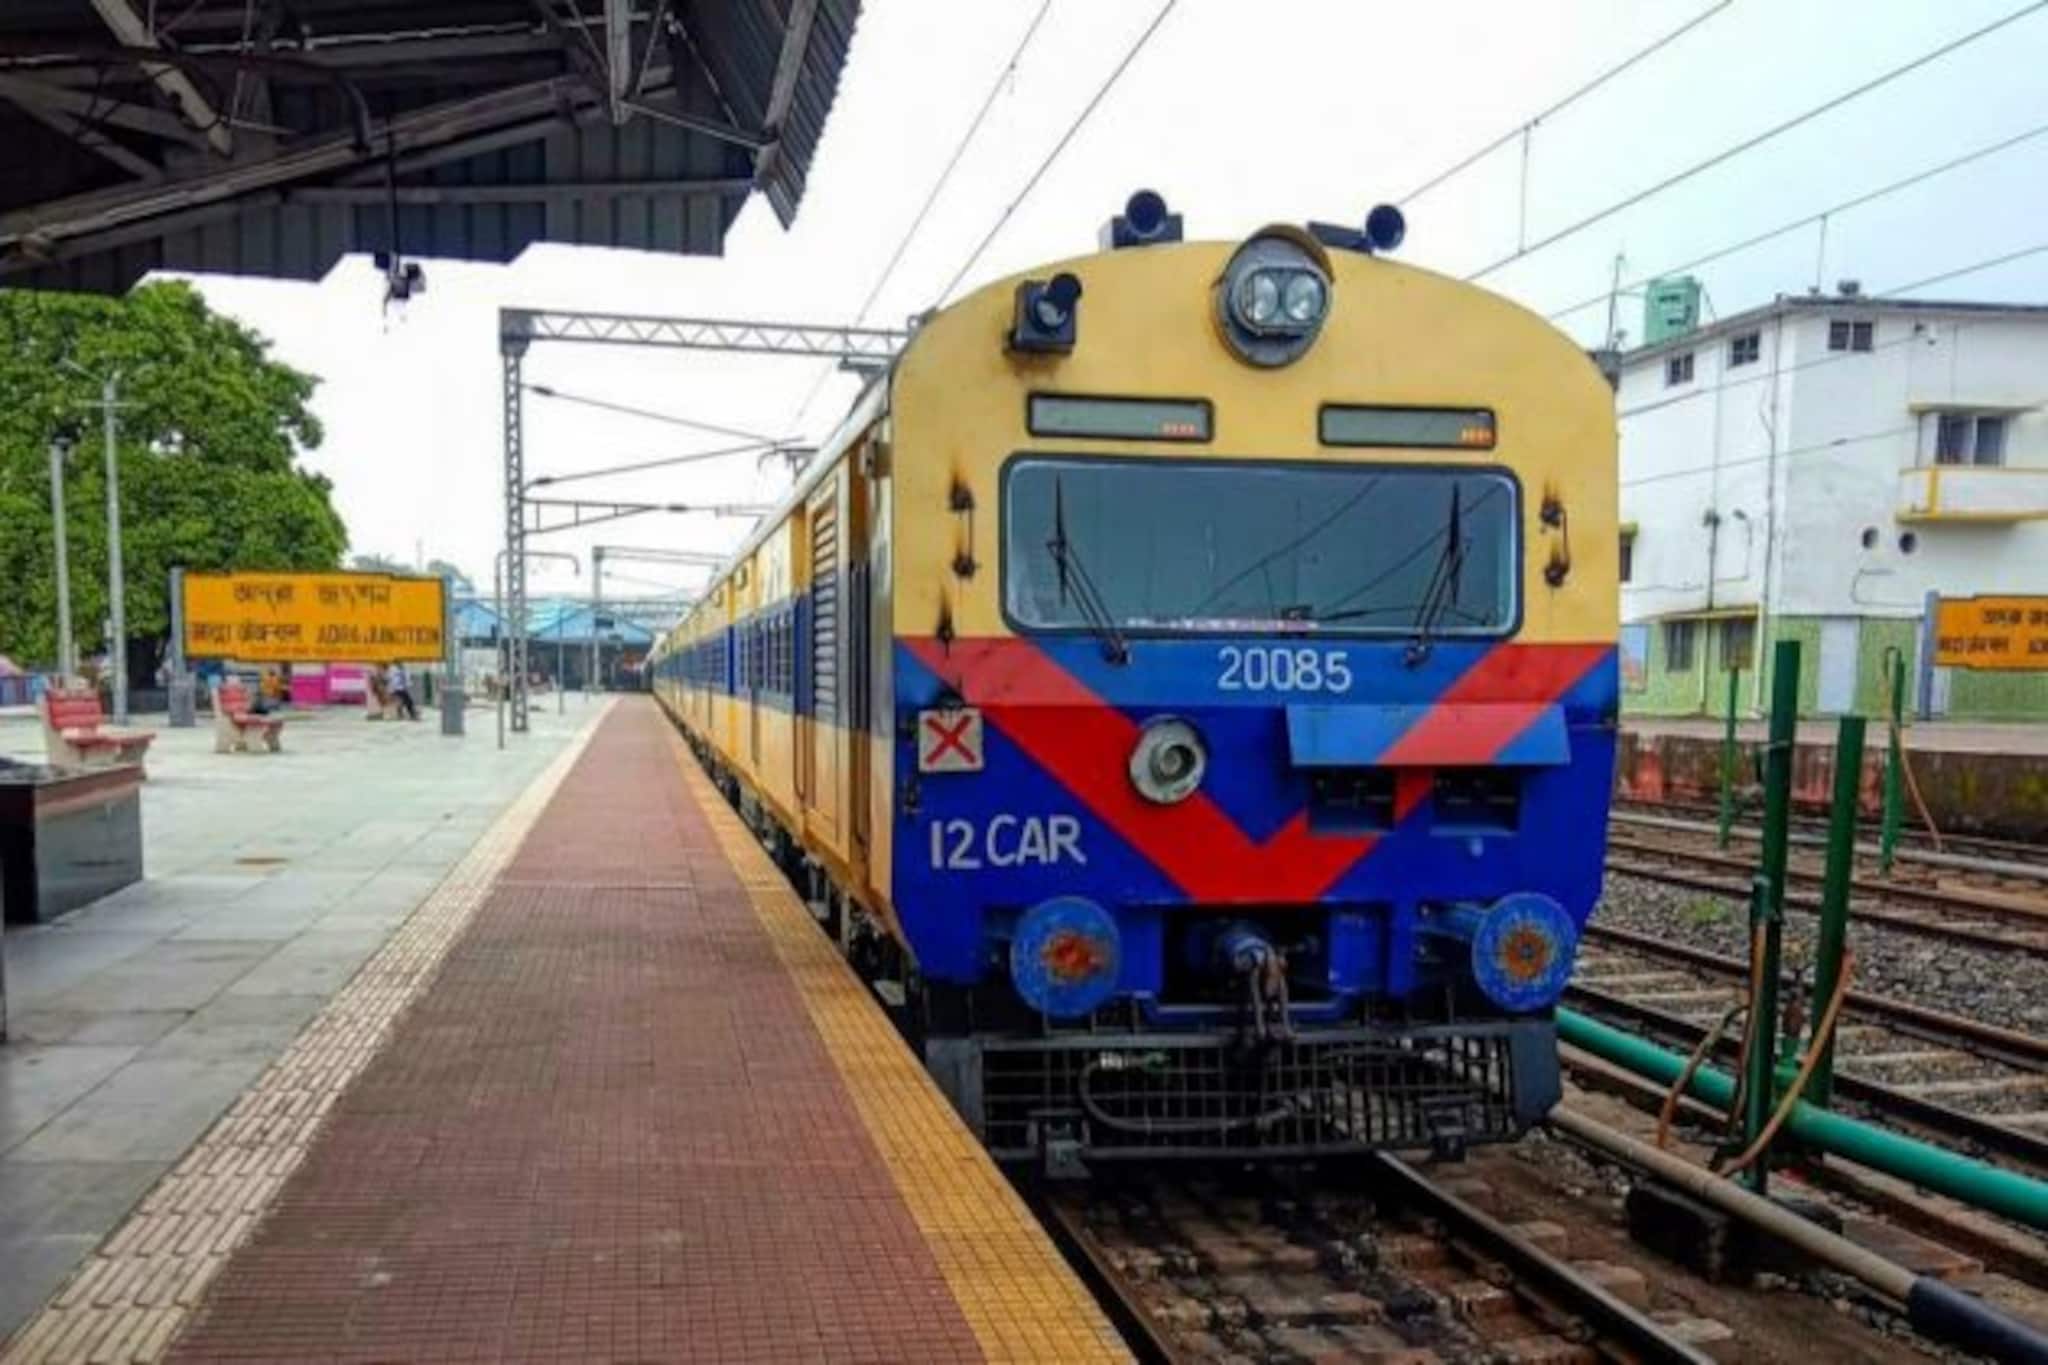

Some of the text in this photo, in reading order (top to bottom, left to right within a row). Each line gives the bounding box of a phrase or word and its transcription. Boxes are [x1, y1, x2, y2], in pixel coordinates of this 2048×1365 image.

[1217, 645, 1353, 694] 20085
[930, 813, 1088, 871] 12 CAR
